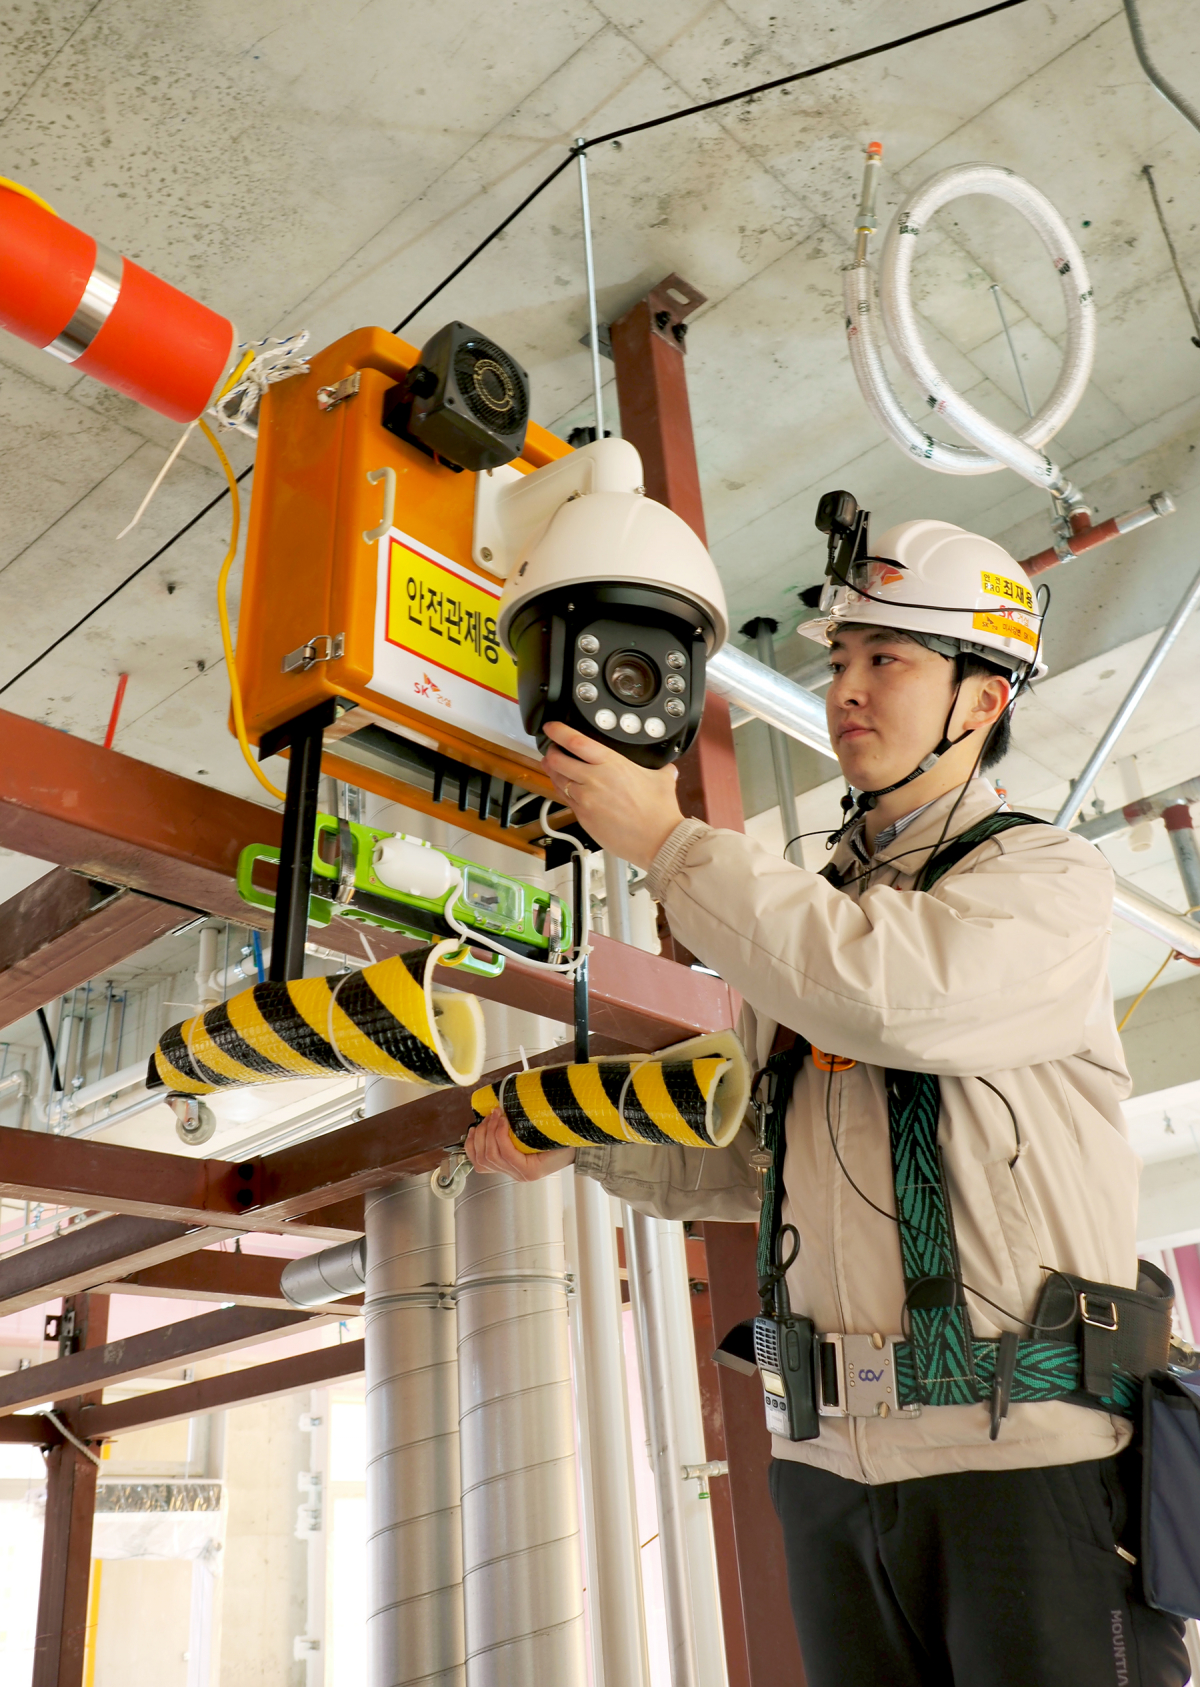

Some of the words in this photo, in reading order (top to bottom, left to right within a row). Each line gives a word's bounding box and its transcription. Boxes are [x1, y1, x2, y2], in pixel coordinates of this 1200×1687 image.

[984, 582, 1000, 593] PRO
[406, 576, 500, 665] 안전관제용
[413, 682, 430, 698] SK
